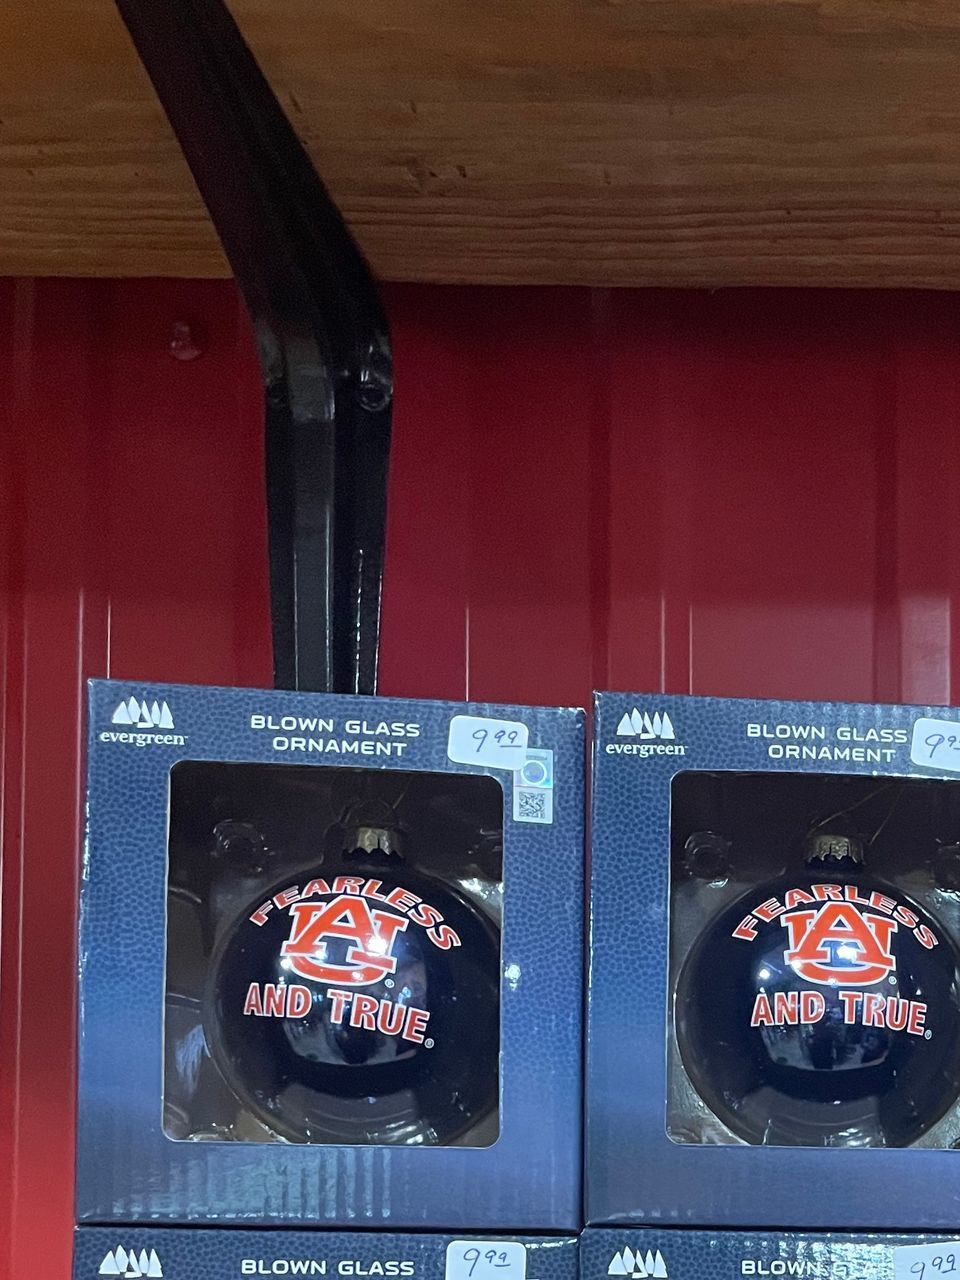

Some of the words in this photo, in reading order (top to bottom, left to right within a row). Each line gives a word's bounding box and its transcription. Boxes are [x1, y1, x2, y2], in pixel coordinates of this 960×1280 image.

[250, 714, 334, 732] BLOWN
[345, 719, 421, 737] GLASS
[747, 723, 825, 740] BLOWN
[836, 727, 908, 743] GLASS
[100, 731, 185, 747] evergreen
[272, 736, 408, 757] ORNAMENT
[606, 743, 686, 758] evergreen
[768, 744, 896, 763] ORNAMENT
[249, 875, 462, 950] FEARLESS
[731, 883, 940, 950] FEARLESS
[243, 982, 312, 1019] AND
[326, 988, 430, 1044] TRUE
[750, 990, 826, 1027] AND
[838, 990, 927, 1037] TRUE
[241, 1259, 327, 1275] BLOWN
[338, 1259, 415, 1276] GLASS
[741, 1259, 820, 1275] BLOWN
